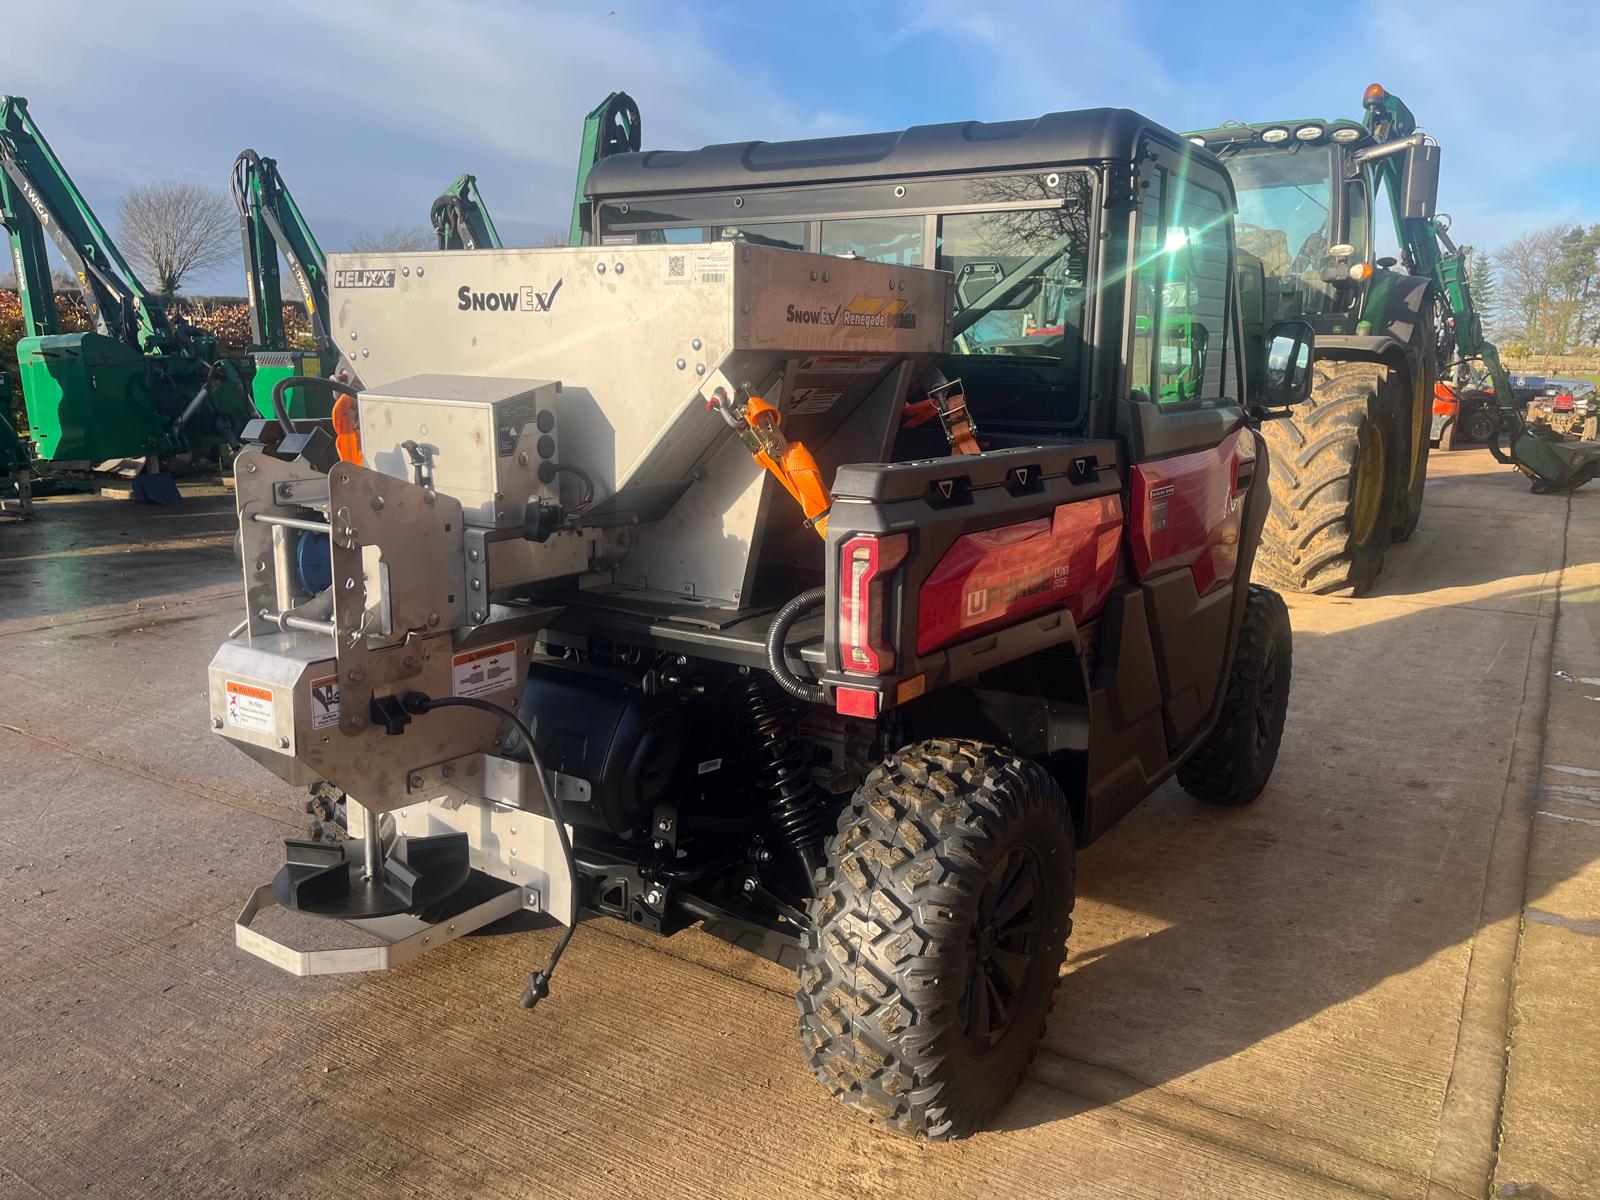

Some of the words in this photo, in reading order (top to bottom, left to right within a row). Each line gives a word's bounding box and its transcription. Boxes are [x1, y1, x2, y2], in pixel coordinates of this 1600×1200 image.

[23, 181, 49, 226] TWIGA
[335, 270, 391, 287] HELIXX
[843, 309, 885, 329] Renegade
